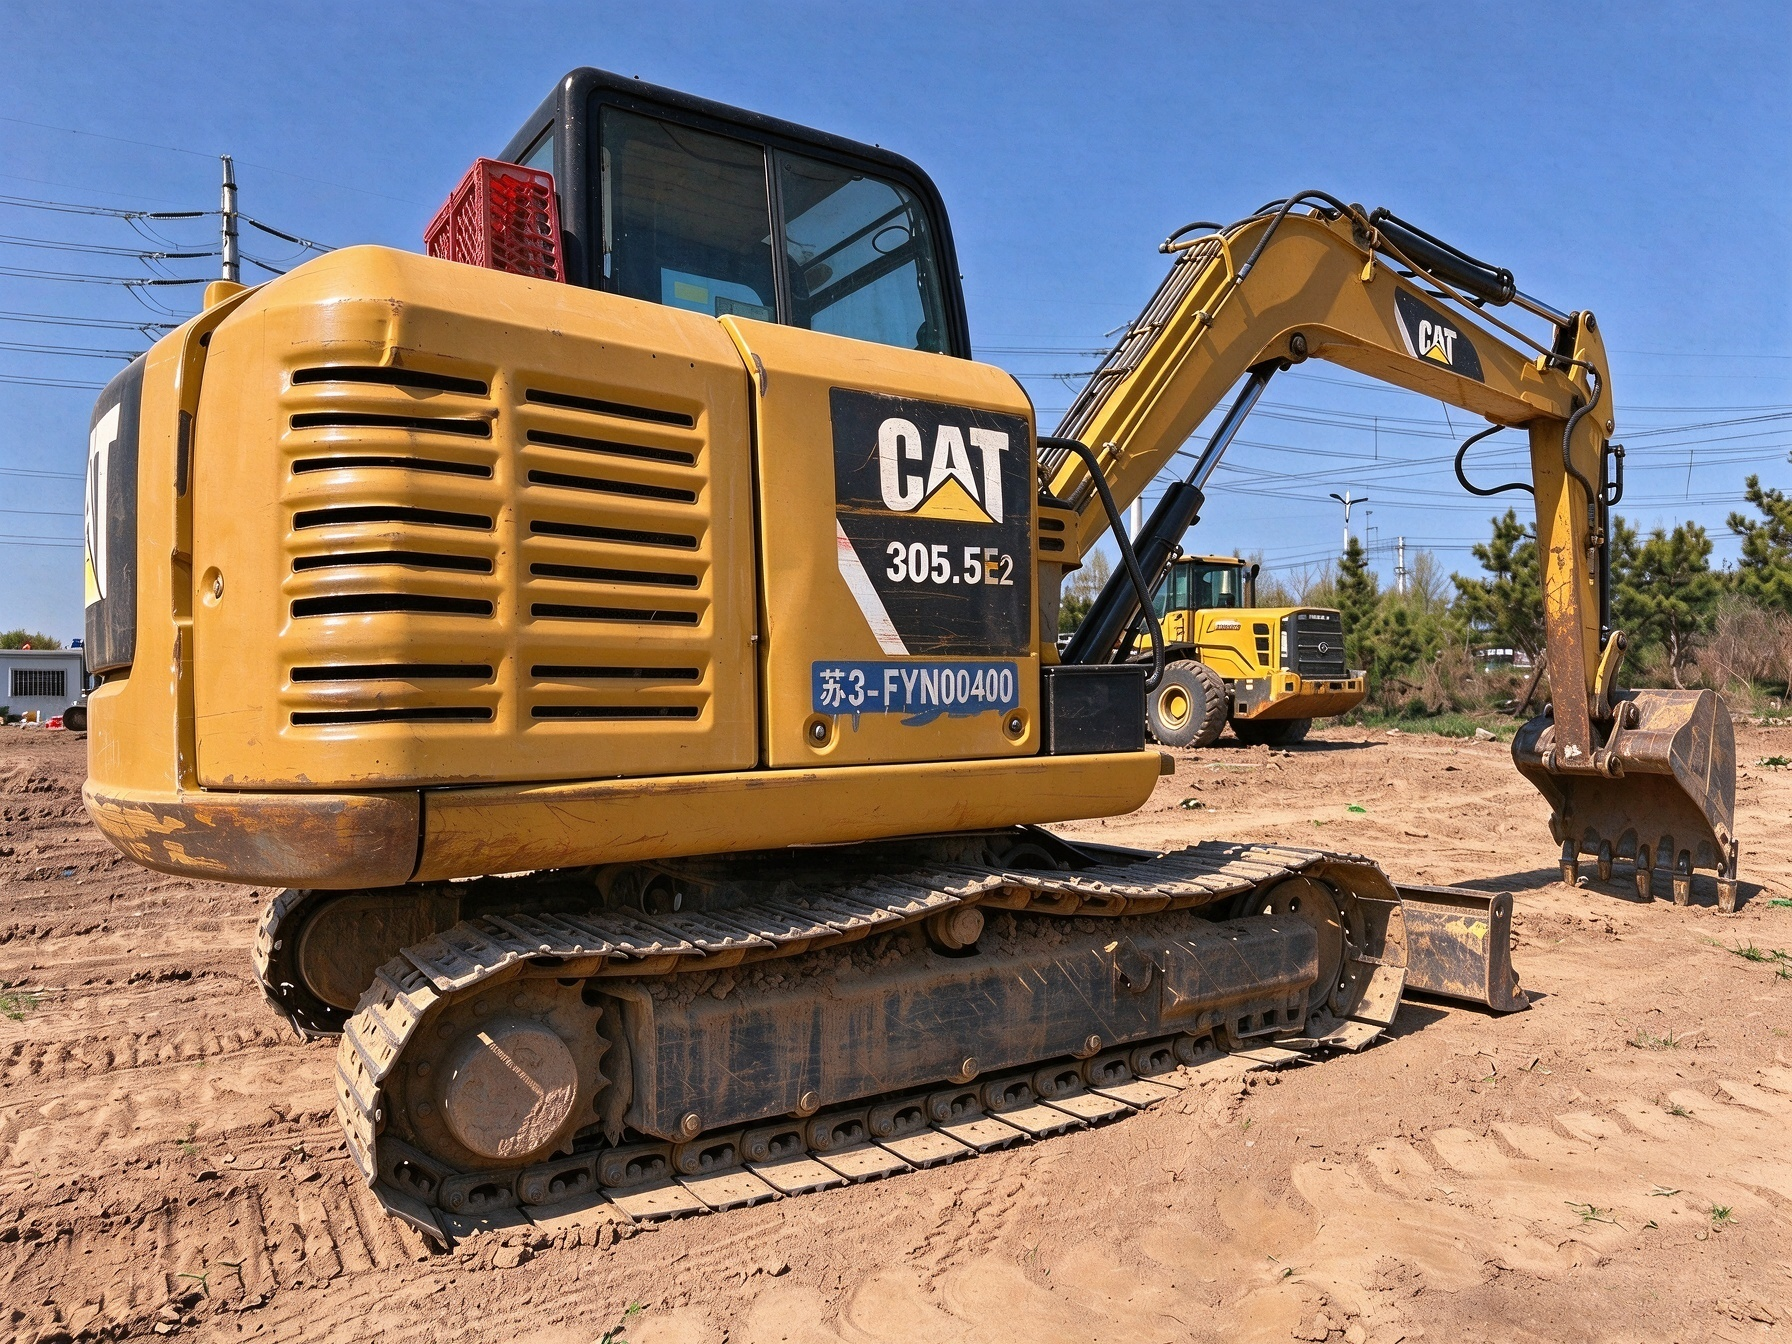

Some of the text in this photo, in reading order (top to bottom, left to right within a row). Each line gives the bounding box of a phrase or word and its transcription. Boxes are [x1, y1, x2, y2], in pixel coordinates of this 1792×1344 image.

[1419, 320, 1457, 365] CAT
[877, 417, 1010, 524] CAT
[885, 541, 1014, 586] 305.5E2
[819, 668, 1014, 708] 苏3-FYN00400
